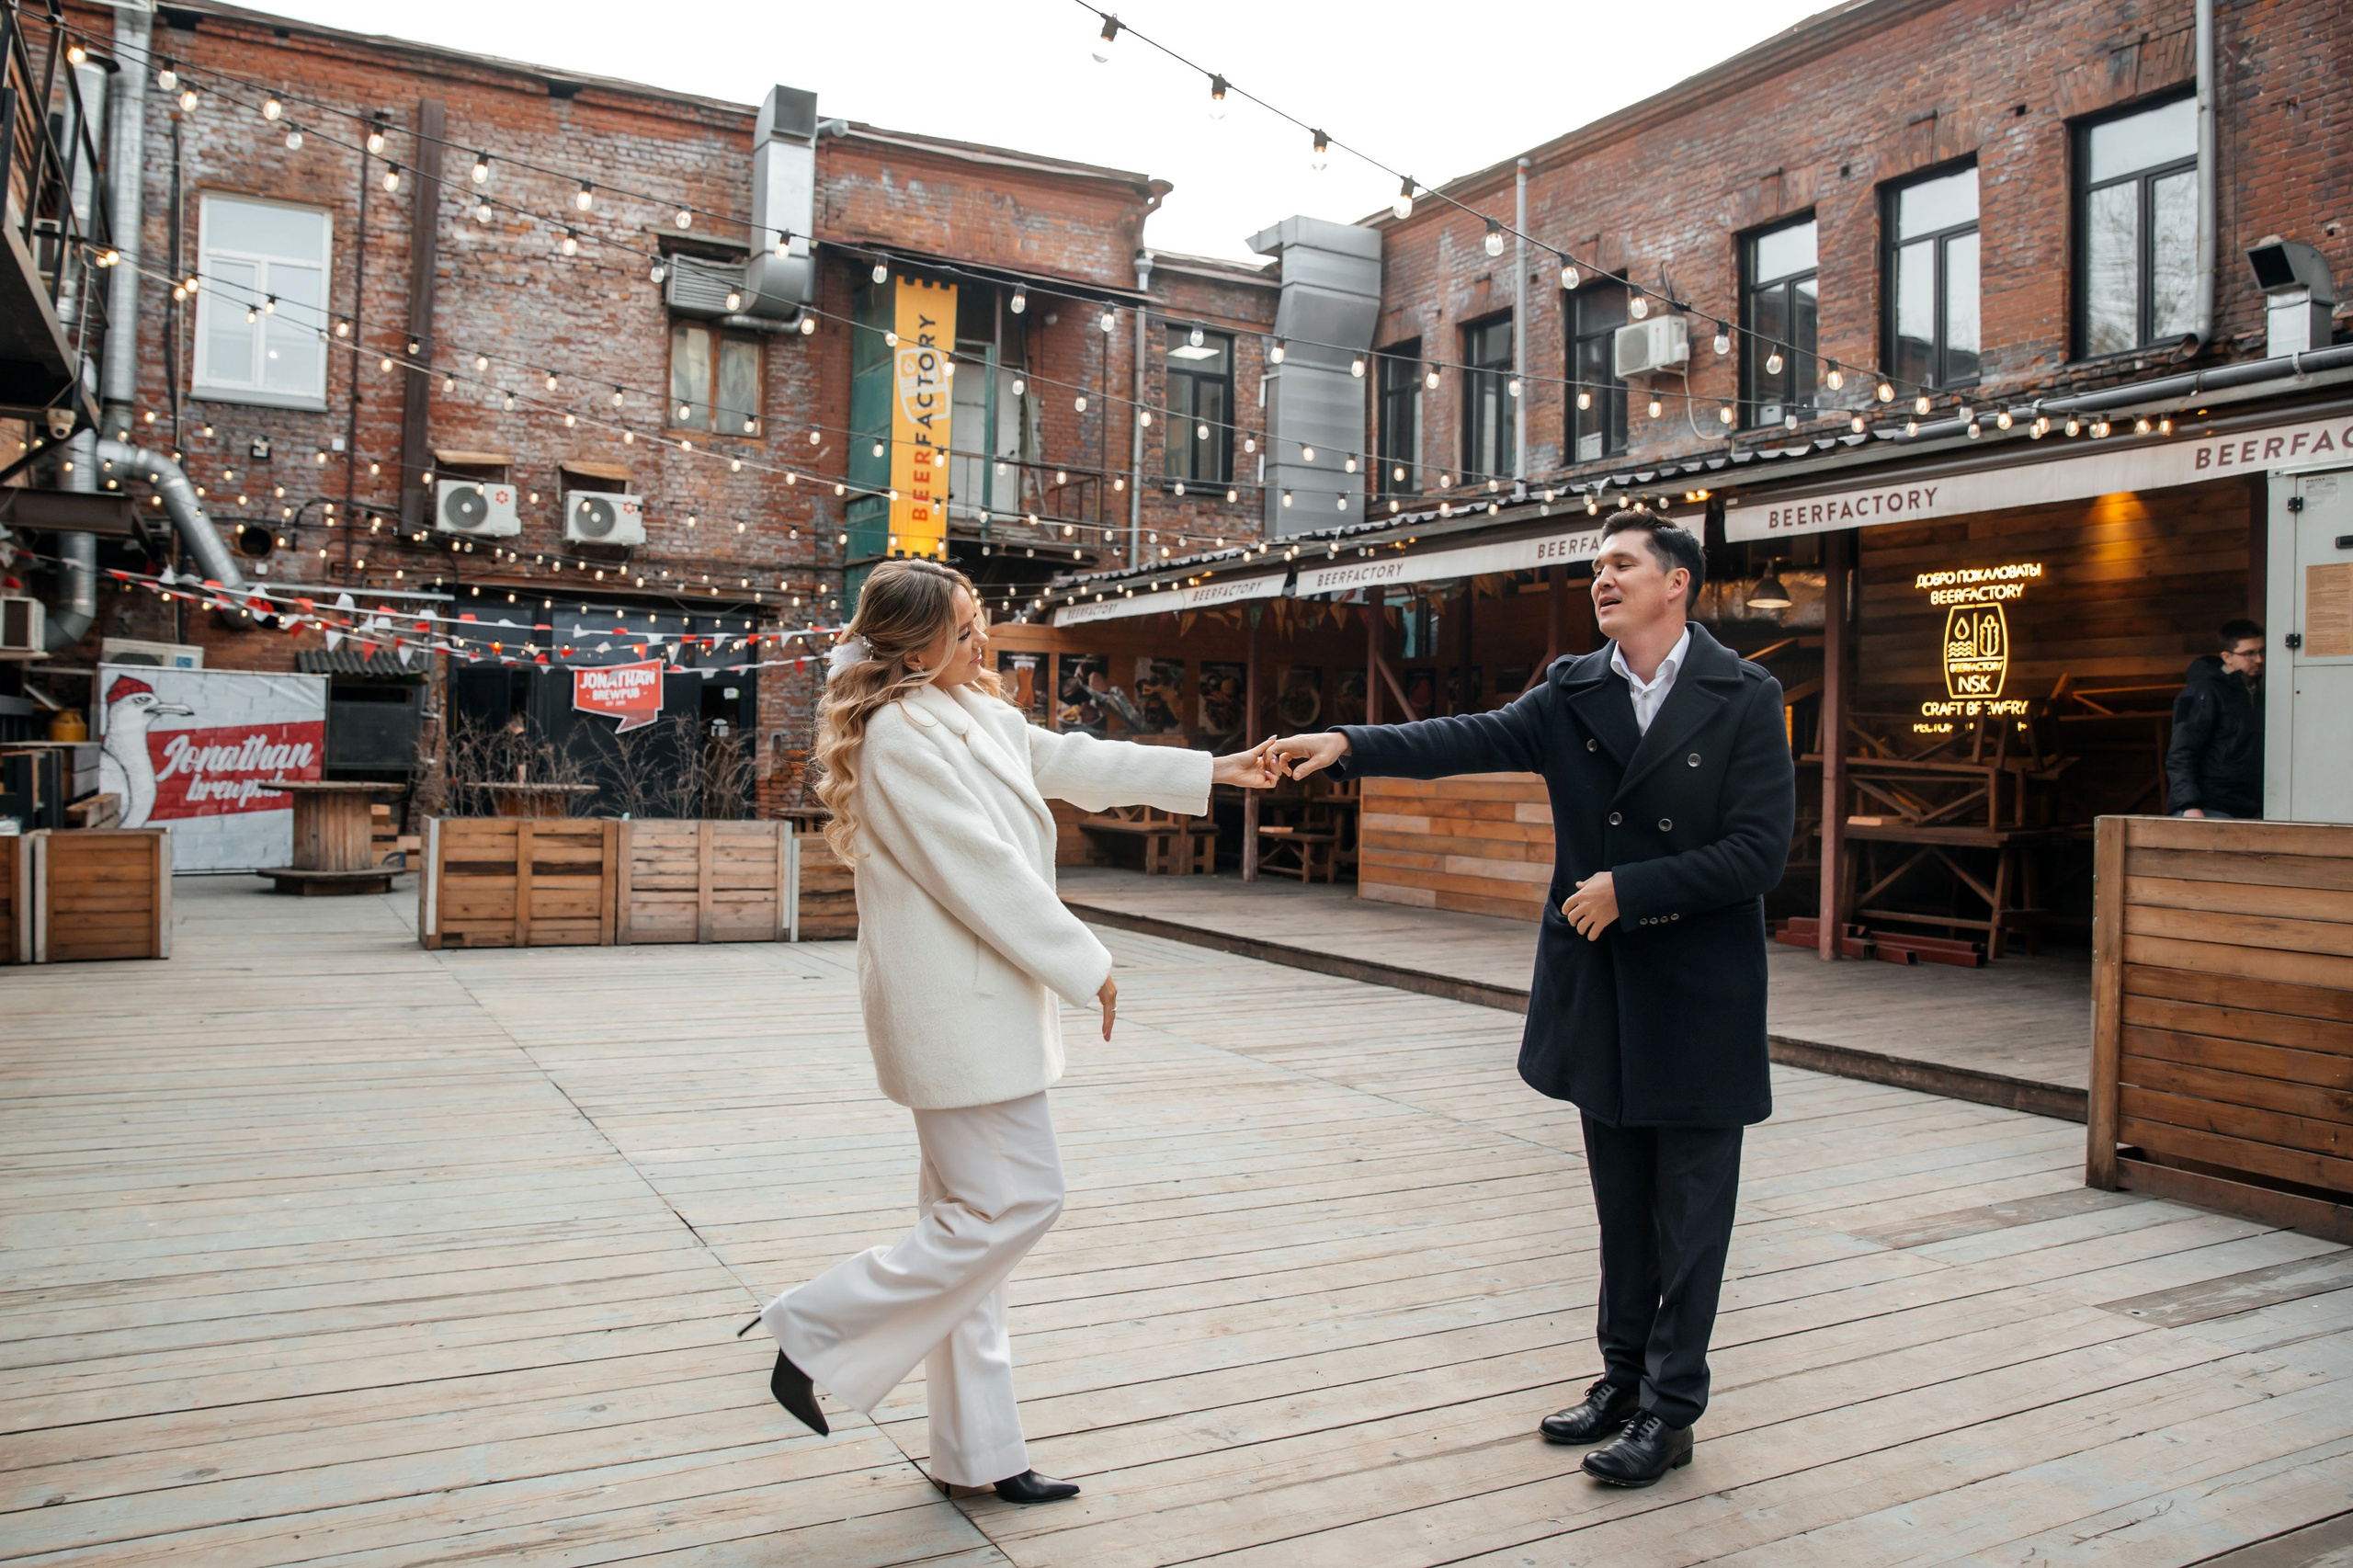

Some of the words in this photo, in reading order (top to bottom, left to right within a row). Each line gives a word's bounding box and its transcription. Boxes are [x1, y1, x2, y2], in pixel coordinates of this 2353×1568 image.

[913, 314, 936, 521] BEERFACTORY
[1768, 487, 1938, 528] BEERFACTORY
[1317, 563, 1404, 587] BEERFACTORY
[1915, 572, 1955, 588] ДОБРО
[1193, 581, 1263, 602] BEERFACTORY
[1931, 583, 2025, 605] BEERFACTORY
[1066, 603, 1119, 619] BEERFACTORY
[579, 670, 656, 689] JONATHAN
[1958, 675, 1992, 694] NSK
[592, 687, 641, 701] BREWPUB
[1922, 701, 1965, 717] CRAFT
[155, 733, 314, 782] Jonathan
